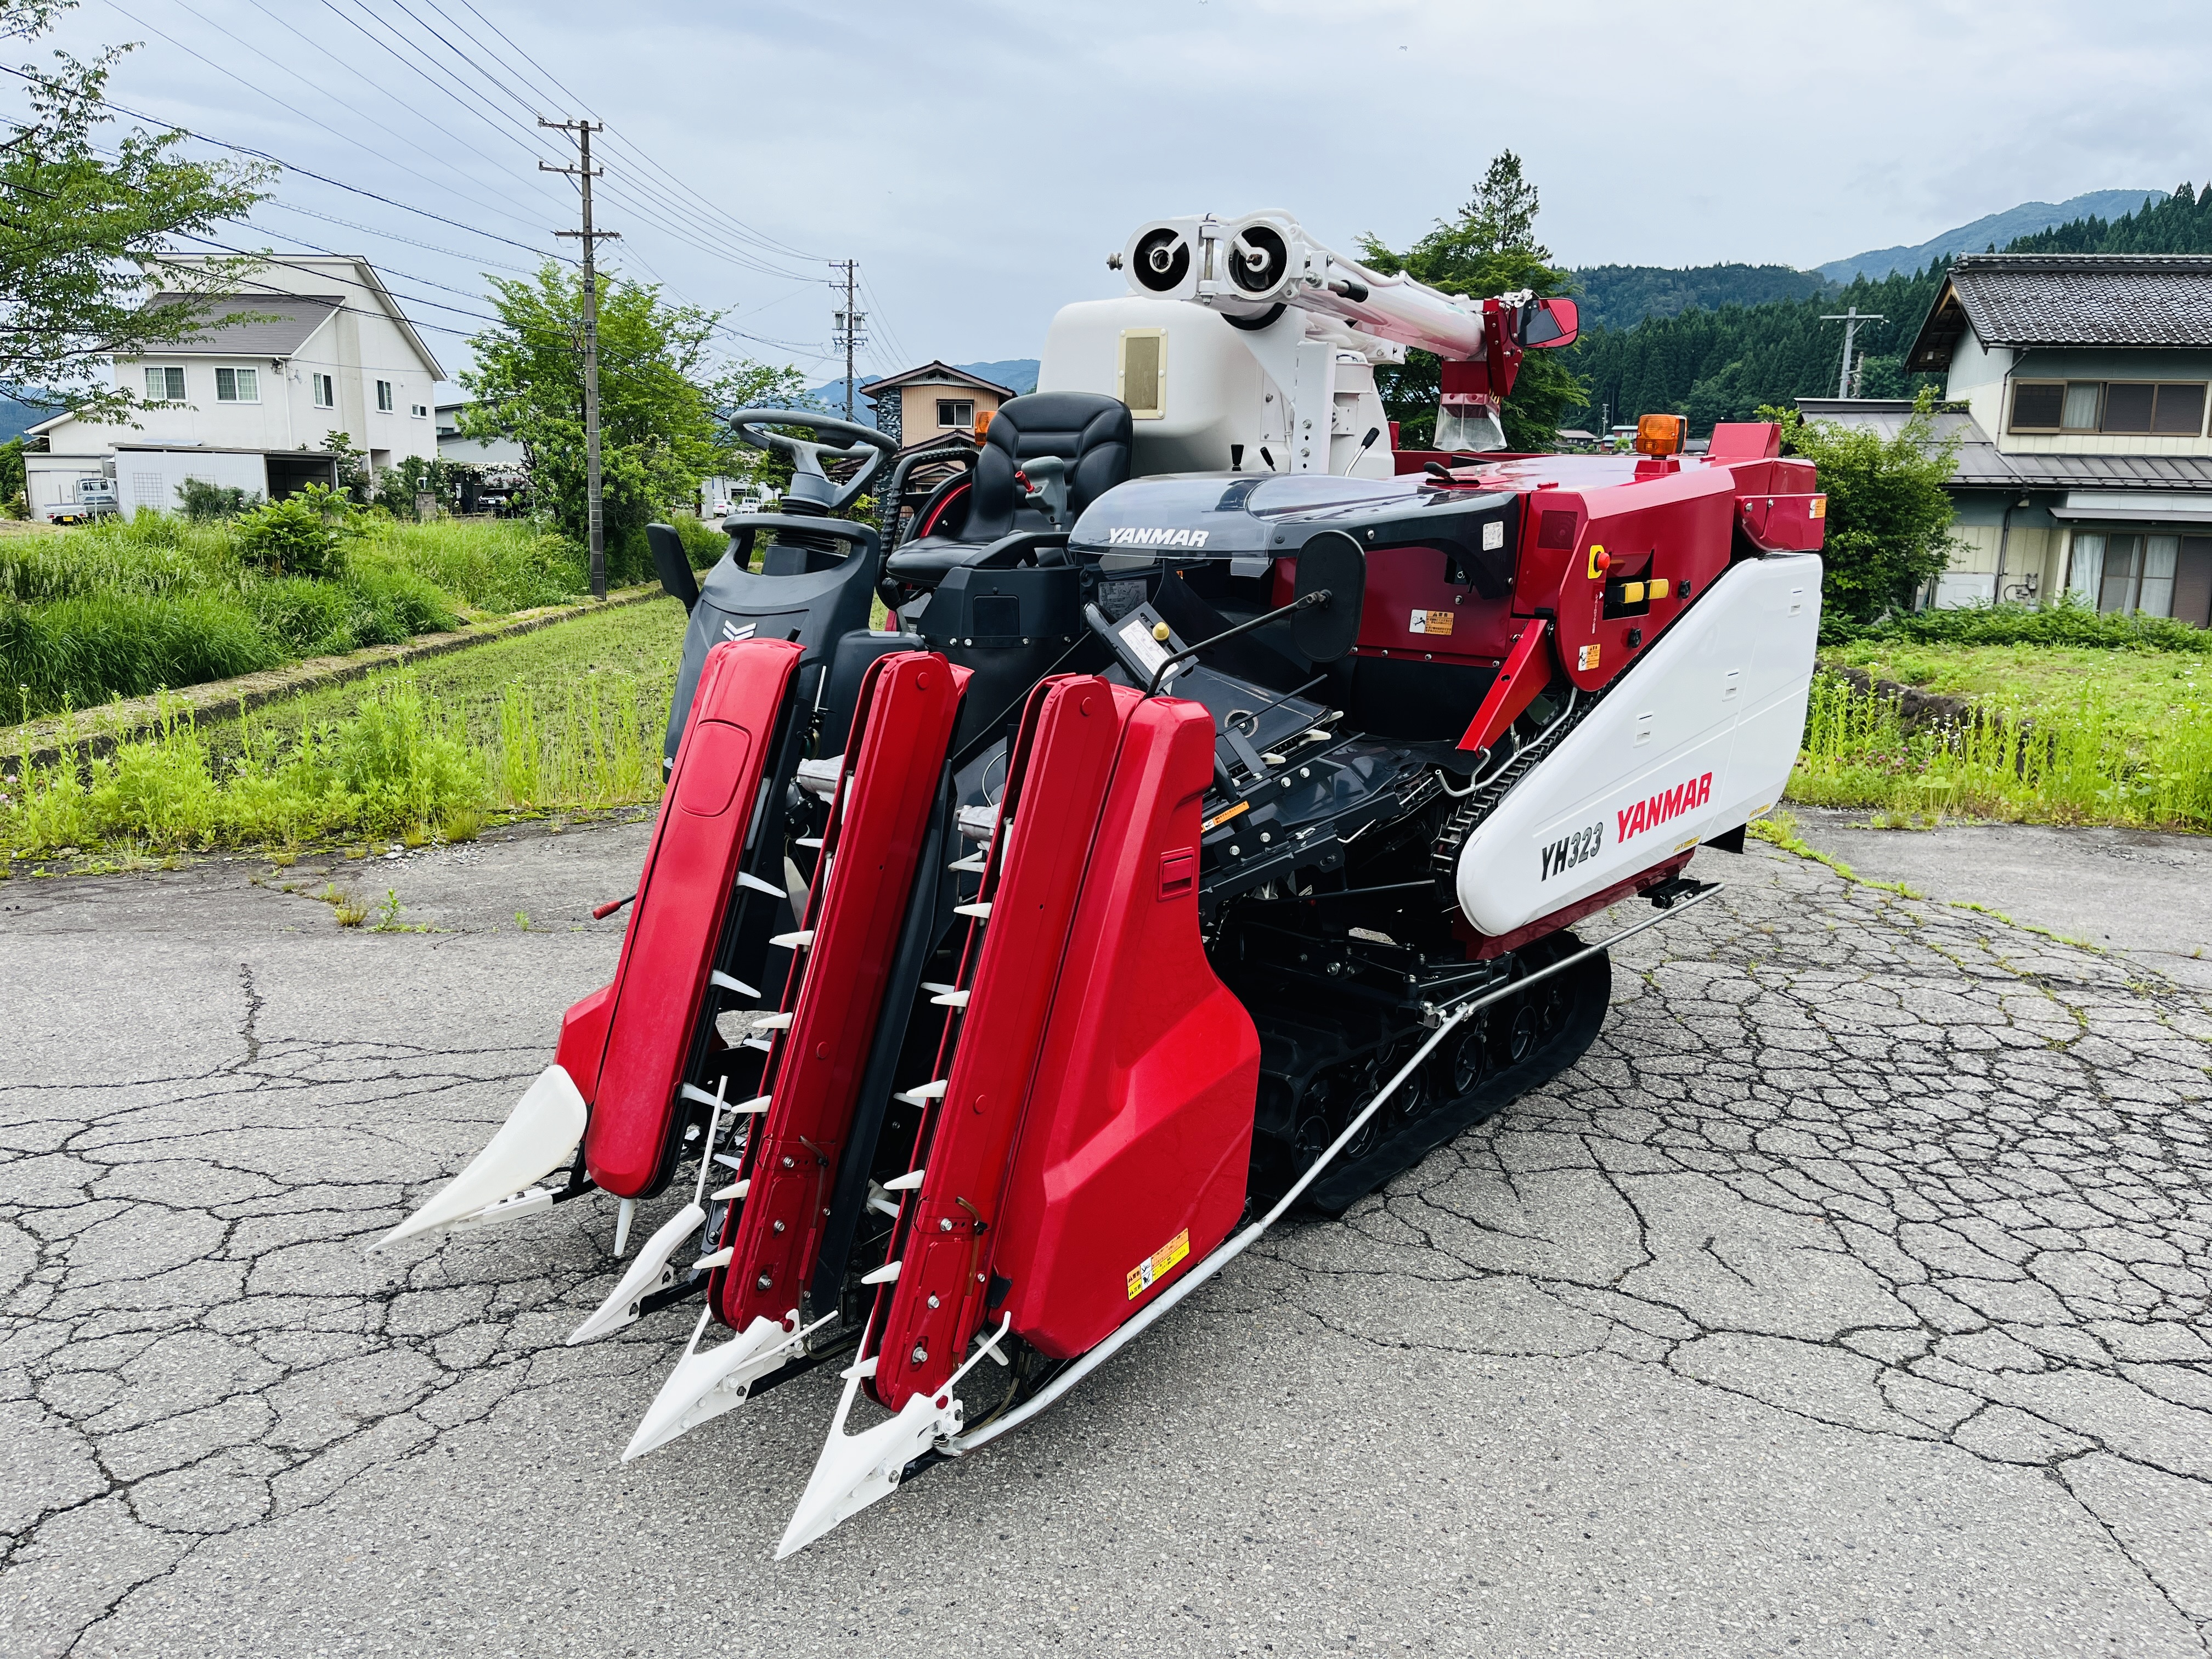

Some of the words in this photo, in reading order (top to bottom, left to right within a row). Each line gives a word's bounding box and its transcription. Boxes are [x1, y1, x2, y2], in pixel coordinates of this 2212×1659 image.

[1109, 528, 1209, 548] YANMAR
[1541, 822, 1603, 882] YH323
[1618, 772, 1712, 843] YANMAR
